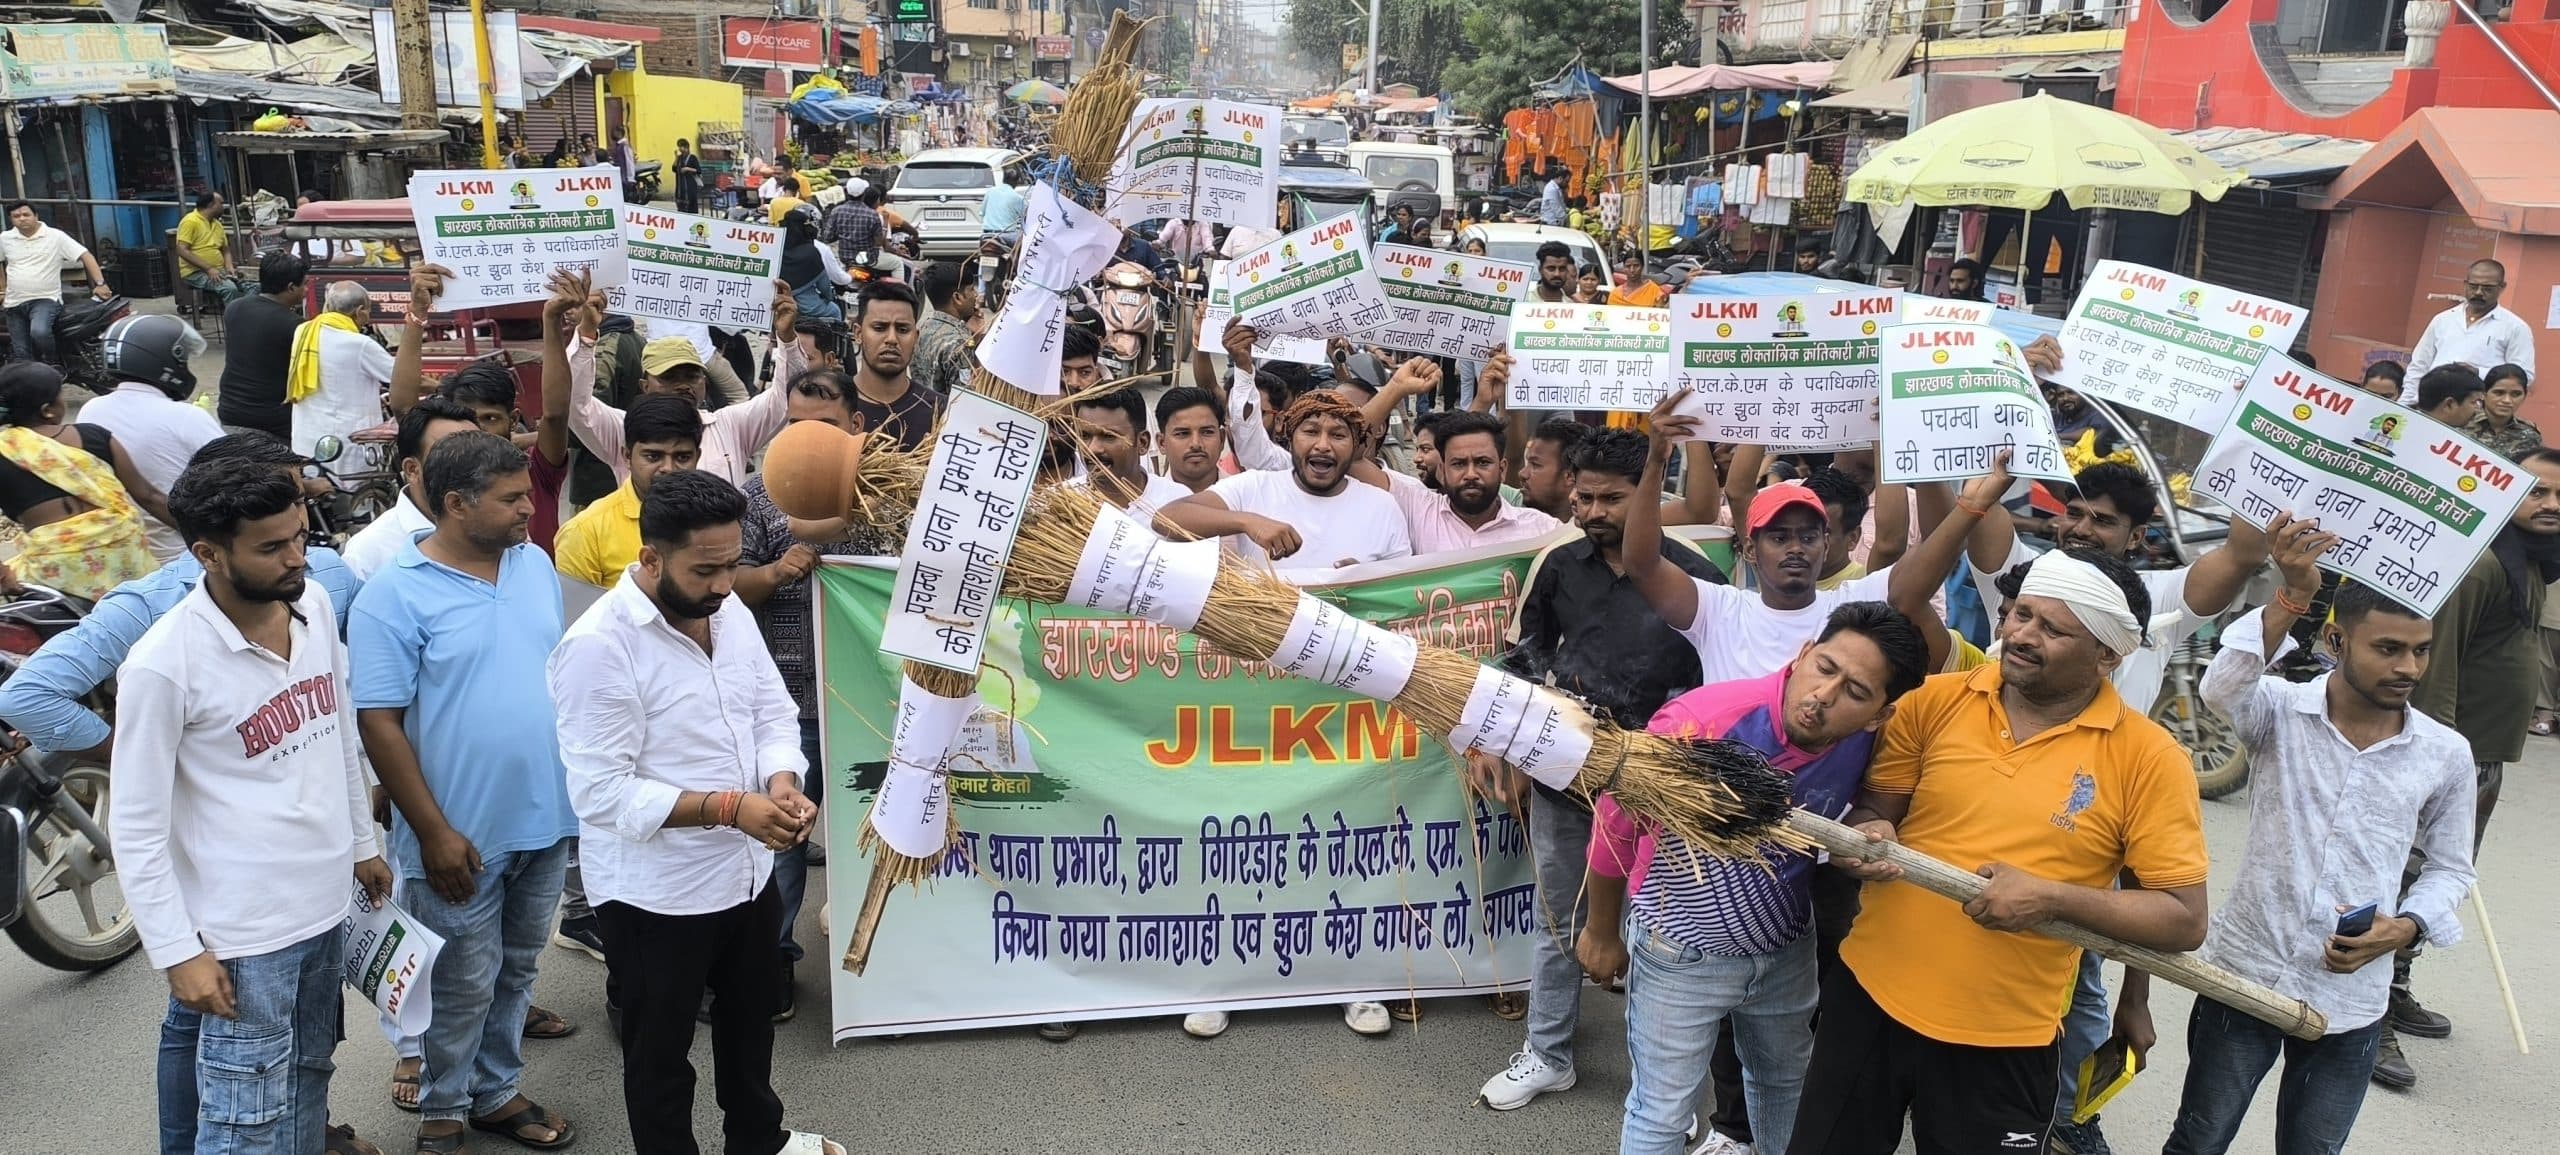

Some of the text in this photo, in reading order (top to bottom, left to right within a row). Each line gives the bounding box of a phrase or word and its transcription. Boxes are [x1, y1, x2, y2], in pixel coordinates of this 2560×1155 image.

[753, 35, 811, 48] BODYCARE
[1224, 110, 1264, 129] JLKM
[1204, 139, 1257, 162] क्रांतिकारी मोर्चा
[436, 177, 612, 196] JLKM JLKM
[1205, 165, 1264, 187] पदाधिकारियों
[443, 209, 607, 233] झारखण्ड लोकतांत्रिक क्रांतिकारी मोर्चा
[1202, 200, 1221, 218] करो
[626, 212, 775, 244] JLKM JLKM
[435, 233, 619, 259] जे.एल.के.एम के पदाधिकारियों
[659, 247, 764, 273] लोकतांत्रिक क्रांतिकारी मोर्चा
[1236, 219, 1353, 277] JLKM JLKM
[463, 261, 544, 280] पर झुठा केश
[1337, 252, 1356, 271] मोर्चा
[1385, 252, 1523, 282] JLKM JLKM
[480, 283, 514, 297] करना
[632, 268, 752, 299] पचम्बा थाना प्रभारी
[2107, 268, 2294, 327] JLKM JLKM
[609, 287, 765, 325] की तानाशाही नहीं चलेगी
[1251, 308, 1288, 329] पचम्बा
[1291, 297, 1320, 319] थाना
[1323, 277, 1359, 309] प्रभारी
[1351, 298, 1388, 328] चलेगी
[1413, 287, 1510, 311] लोकतांत्रिक क्रांतिकारी मोर्चा
[1525, 308, 1574, 319] JLKM
[1691, 297, 1893, 319] JLKM JLKM
[1924, 305, 1980, 322] JLKM
[1427, 310, 1495, 337] थाना प्रभारी
[2089, 304, 2266, 362] झारखण्ड लोकतांत्रिक क्रांतिकारी मोर्चा
[1383, 328, 1464, 355] तानाशाही नहीं
[1524, 334, 1666, 349] झारखण्ड लोकतांत्रिक क्रांतिकारी मोर्चा
[1692, 341, 1852, 364] झारखण्ड लोकतांत्रिक क्रांतिकारी
[1901, 331, 1975, 349] JLKM
[2067, 320, 2168, 363] जे.एल.के.एम के
[1532, 354, 1654, 377] पचम्बा थाना प्रभारी
[2079, 349, 2223, 404] पर झुठा केश मुकदमा
[1515, 379, 1624, 405] की तानाशाही नहीं
[1678, 372, 1794, 394] जे.एल.के.एम के
[1904, 369, 2021, 393] झारखण्ड लोकतांत्रिक
[2081, 375, 2180, 414] करना बंद करो
[1705, 397, 1864, 422] पर झुठा केश मुकदमा
[1921, 403, 2034, 432] पचम्बा थाना
[1720, 417, 1830, 440] करना बंद करो
[2274, 370, 2515, 492] JLKM JLKM
[1895, 440, 1920, 474] की
[2250, 413, 2477, 527] झारखण्ड लोकतांत्रिक क्रांतिकारी मोर्चा
[2249, 451, 2309, 501] पचम्बा
[2315, 485, 2366, 521] थाना
[2368, 507, 2438, 555] प्रभारी
[904, 432, 983, 614] पचम्बा थाना प्रभारी
[935, 420, 1037, 655] की तानाशाही नहीं चलेगी
[2207, 467, 2439, 604] की चलेगी
[1096, 520, 1130, 584] थाना प्रभारी
[1147, 555, 1168, 590] कुमार
[1038, 617, 1182, 684] झारखण्ड
[1298, 630, 1323, 662] थाना
[1354, 636, 1379, 675] कुमार
[1480, 700, 1504, 735] थाना
[1536, 706, 1562, 747] कुमार
[1145, 701, 1420, 768] JLKM
[921, 782, 942, 824] राजीव
[2050, 812, 2076, 832] USPA
[988, 833, 1044, 886] थाना
[1051, 814, 1128, 895] प्रभारी,
[1136, 837, 1183, 894] द्वारा
[1297, 812, 1320, 881] के
[1424, 820, 1463, 877] एम.
[1473, 799, 1493, 863] के
[992, 890, 1051, 965] किया
[1057, 915, 1110, 962] गया
[1116, 892, 1225, 966] तानाशाही
[1273, 910, 1318, 977] झुठा
[1323, 889, 1367, 958] केश
[1373, 901, 1437, 951] वापस
[1443, 880, 1474, 955] लो,
[1482, 882, 1536, 940] वापस
[387, 953, 417, 1016] JLKM
